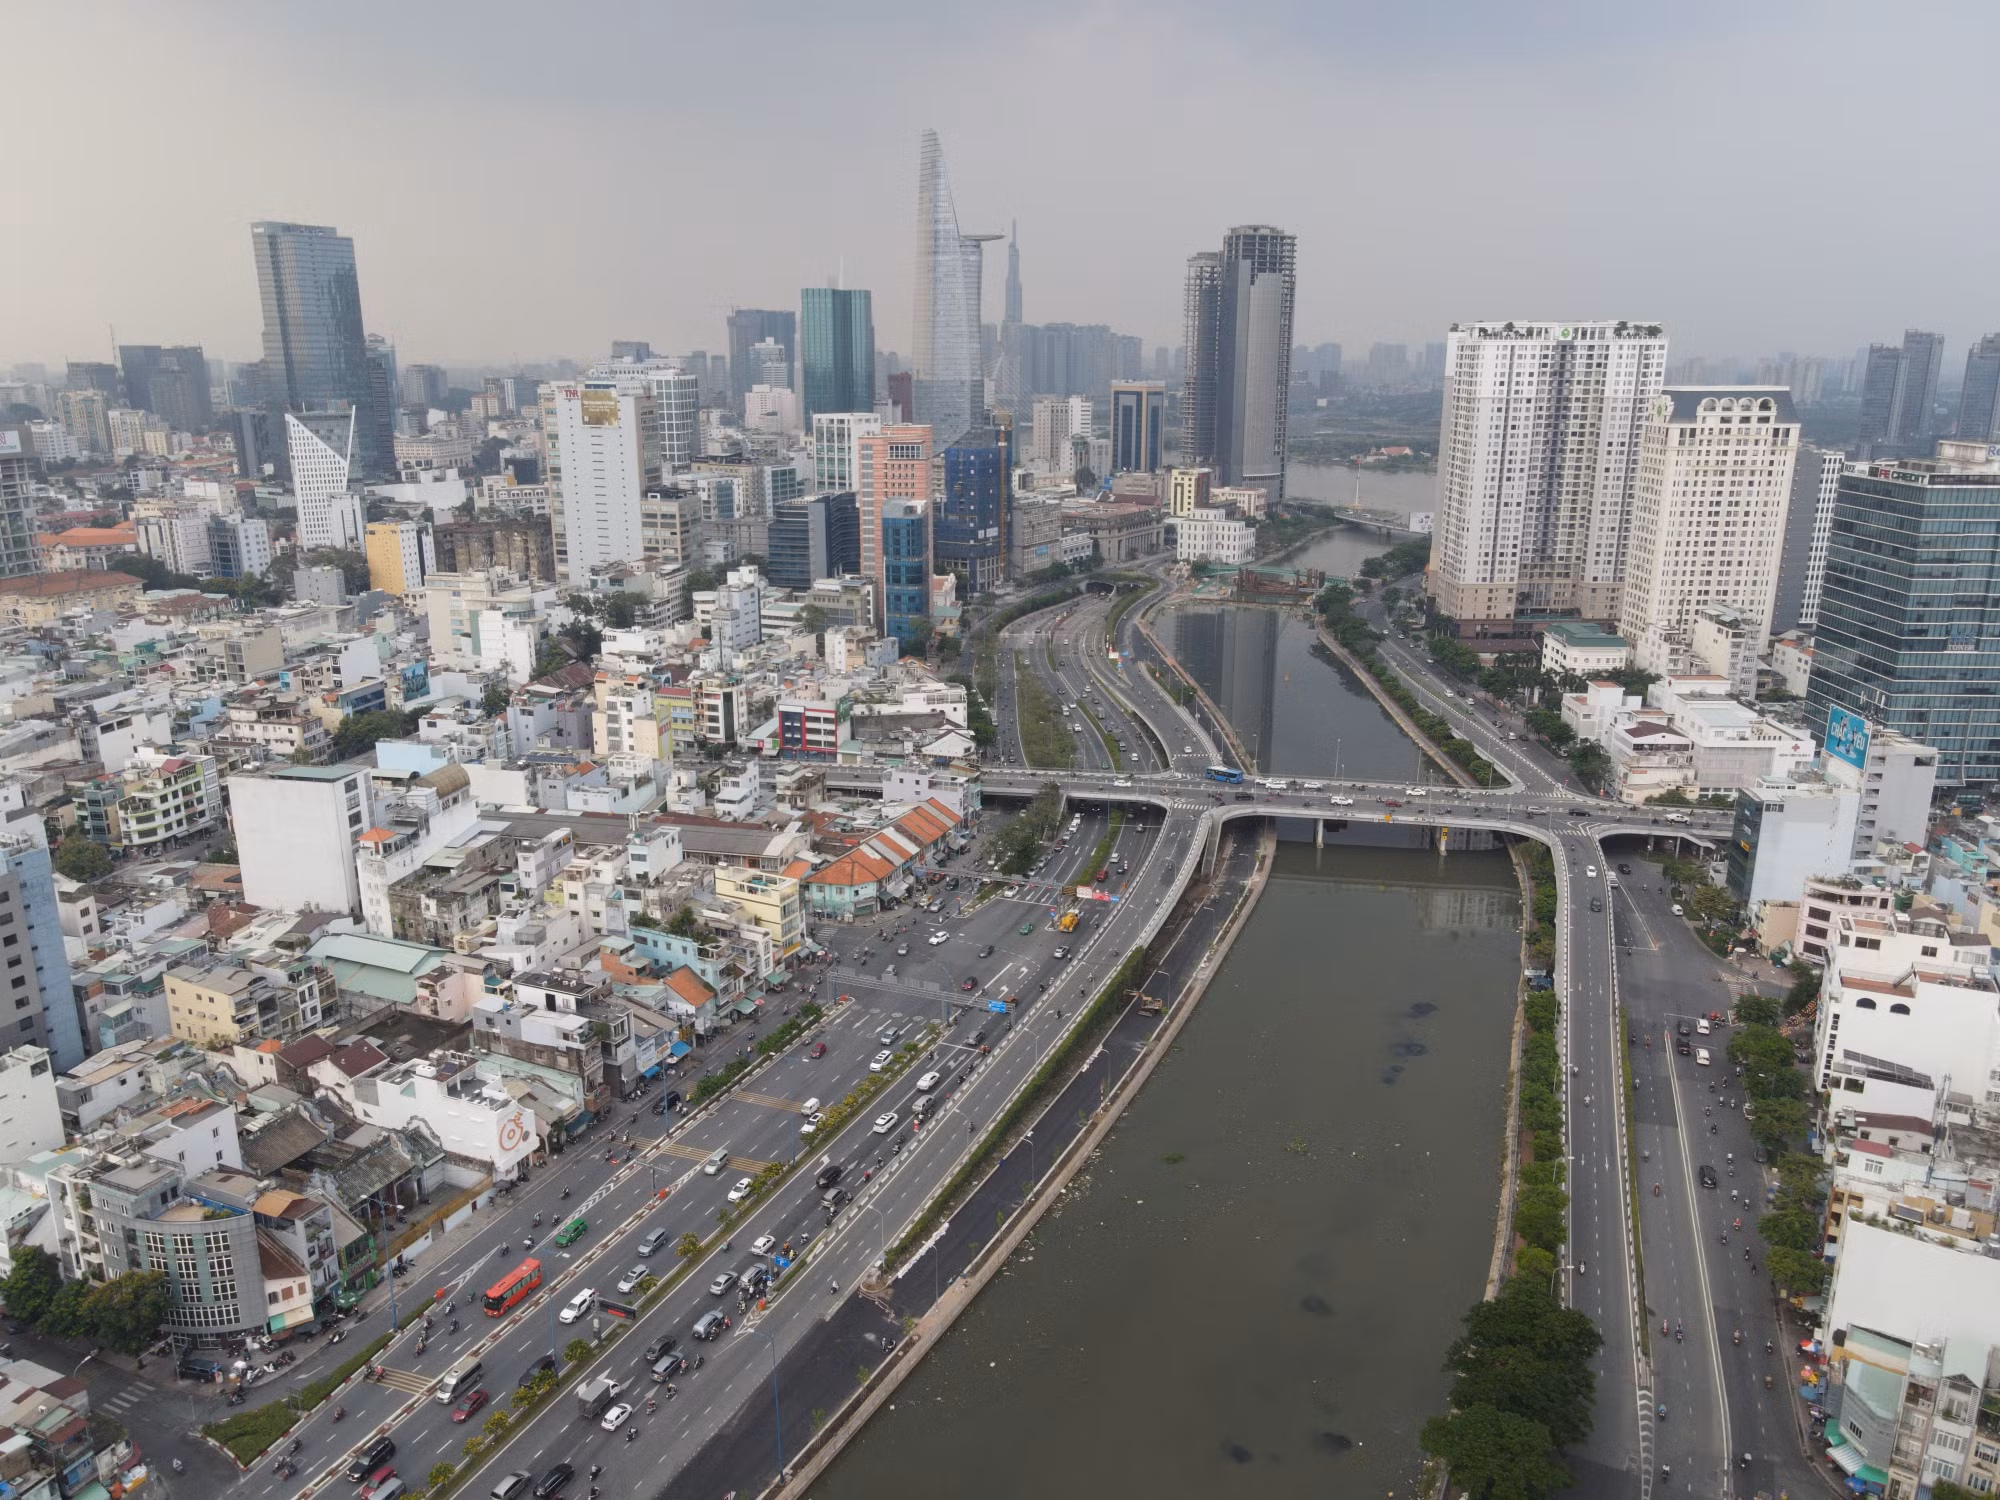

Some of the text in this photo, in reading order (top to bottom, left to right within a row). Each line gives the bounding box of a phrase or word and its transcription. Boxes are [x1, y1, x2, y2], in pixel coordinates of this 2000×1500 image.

[564, 390, 579, 398] TNR
[1880, 468, 1927, 484] FE CREDIT
